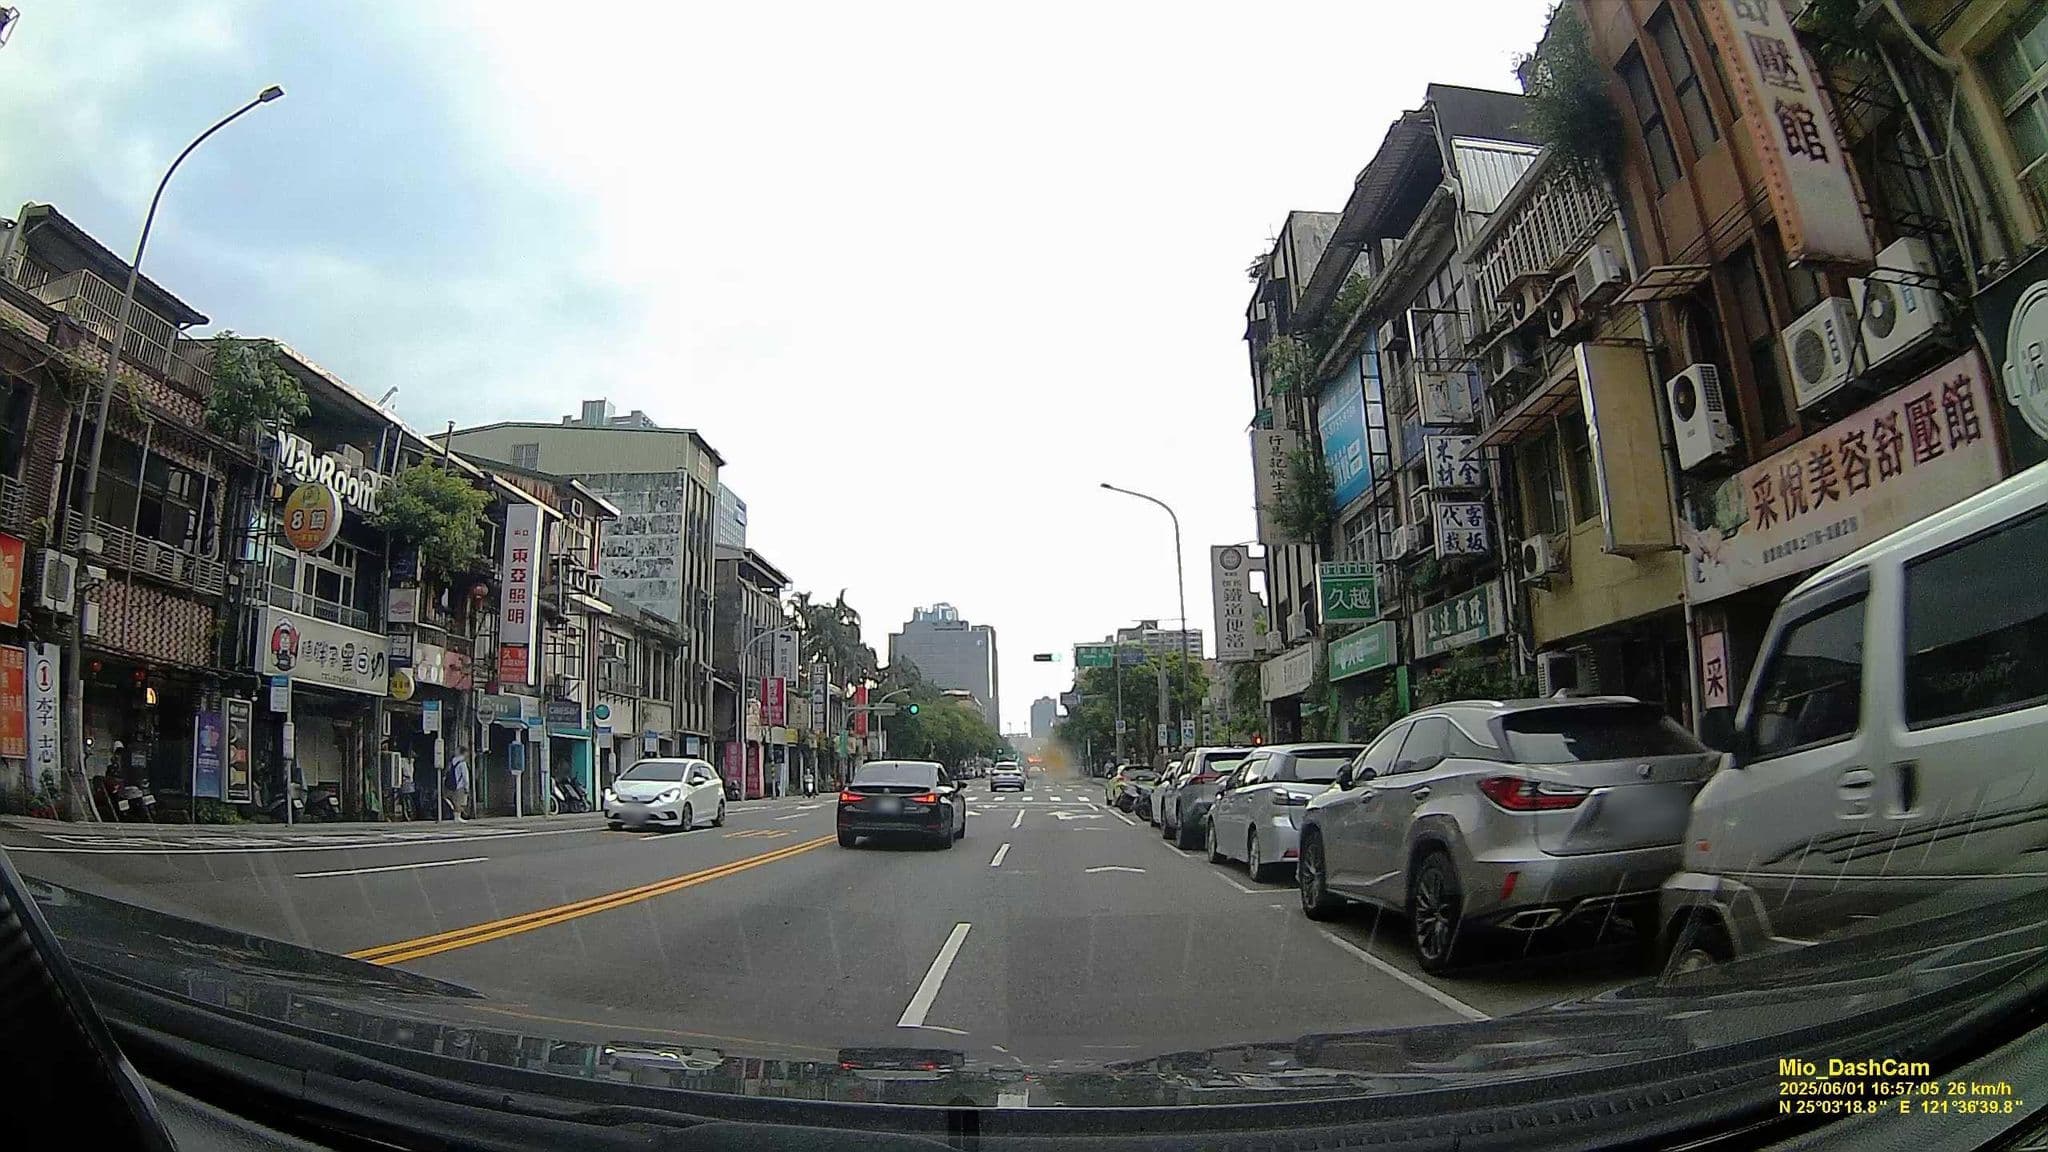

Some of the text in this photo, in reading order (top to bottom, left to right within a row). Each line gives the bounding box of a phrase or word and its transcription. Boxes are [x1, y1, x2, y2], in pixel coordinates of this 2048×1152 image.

[1751, 374, 1983, 532] 采悅美容舒壓館
[507, 548, 529, 624] 東亞照明
[1328, 586, 1371, 610] 久越
[1706, 658, 1724, 698] 采
